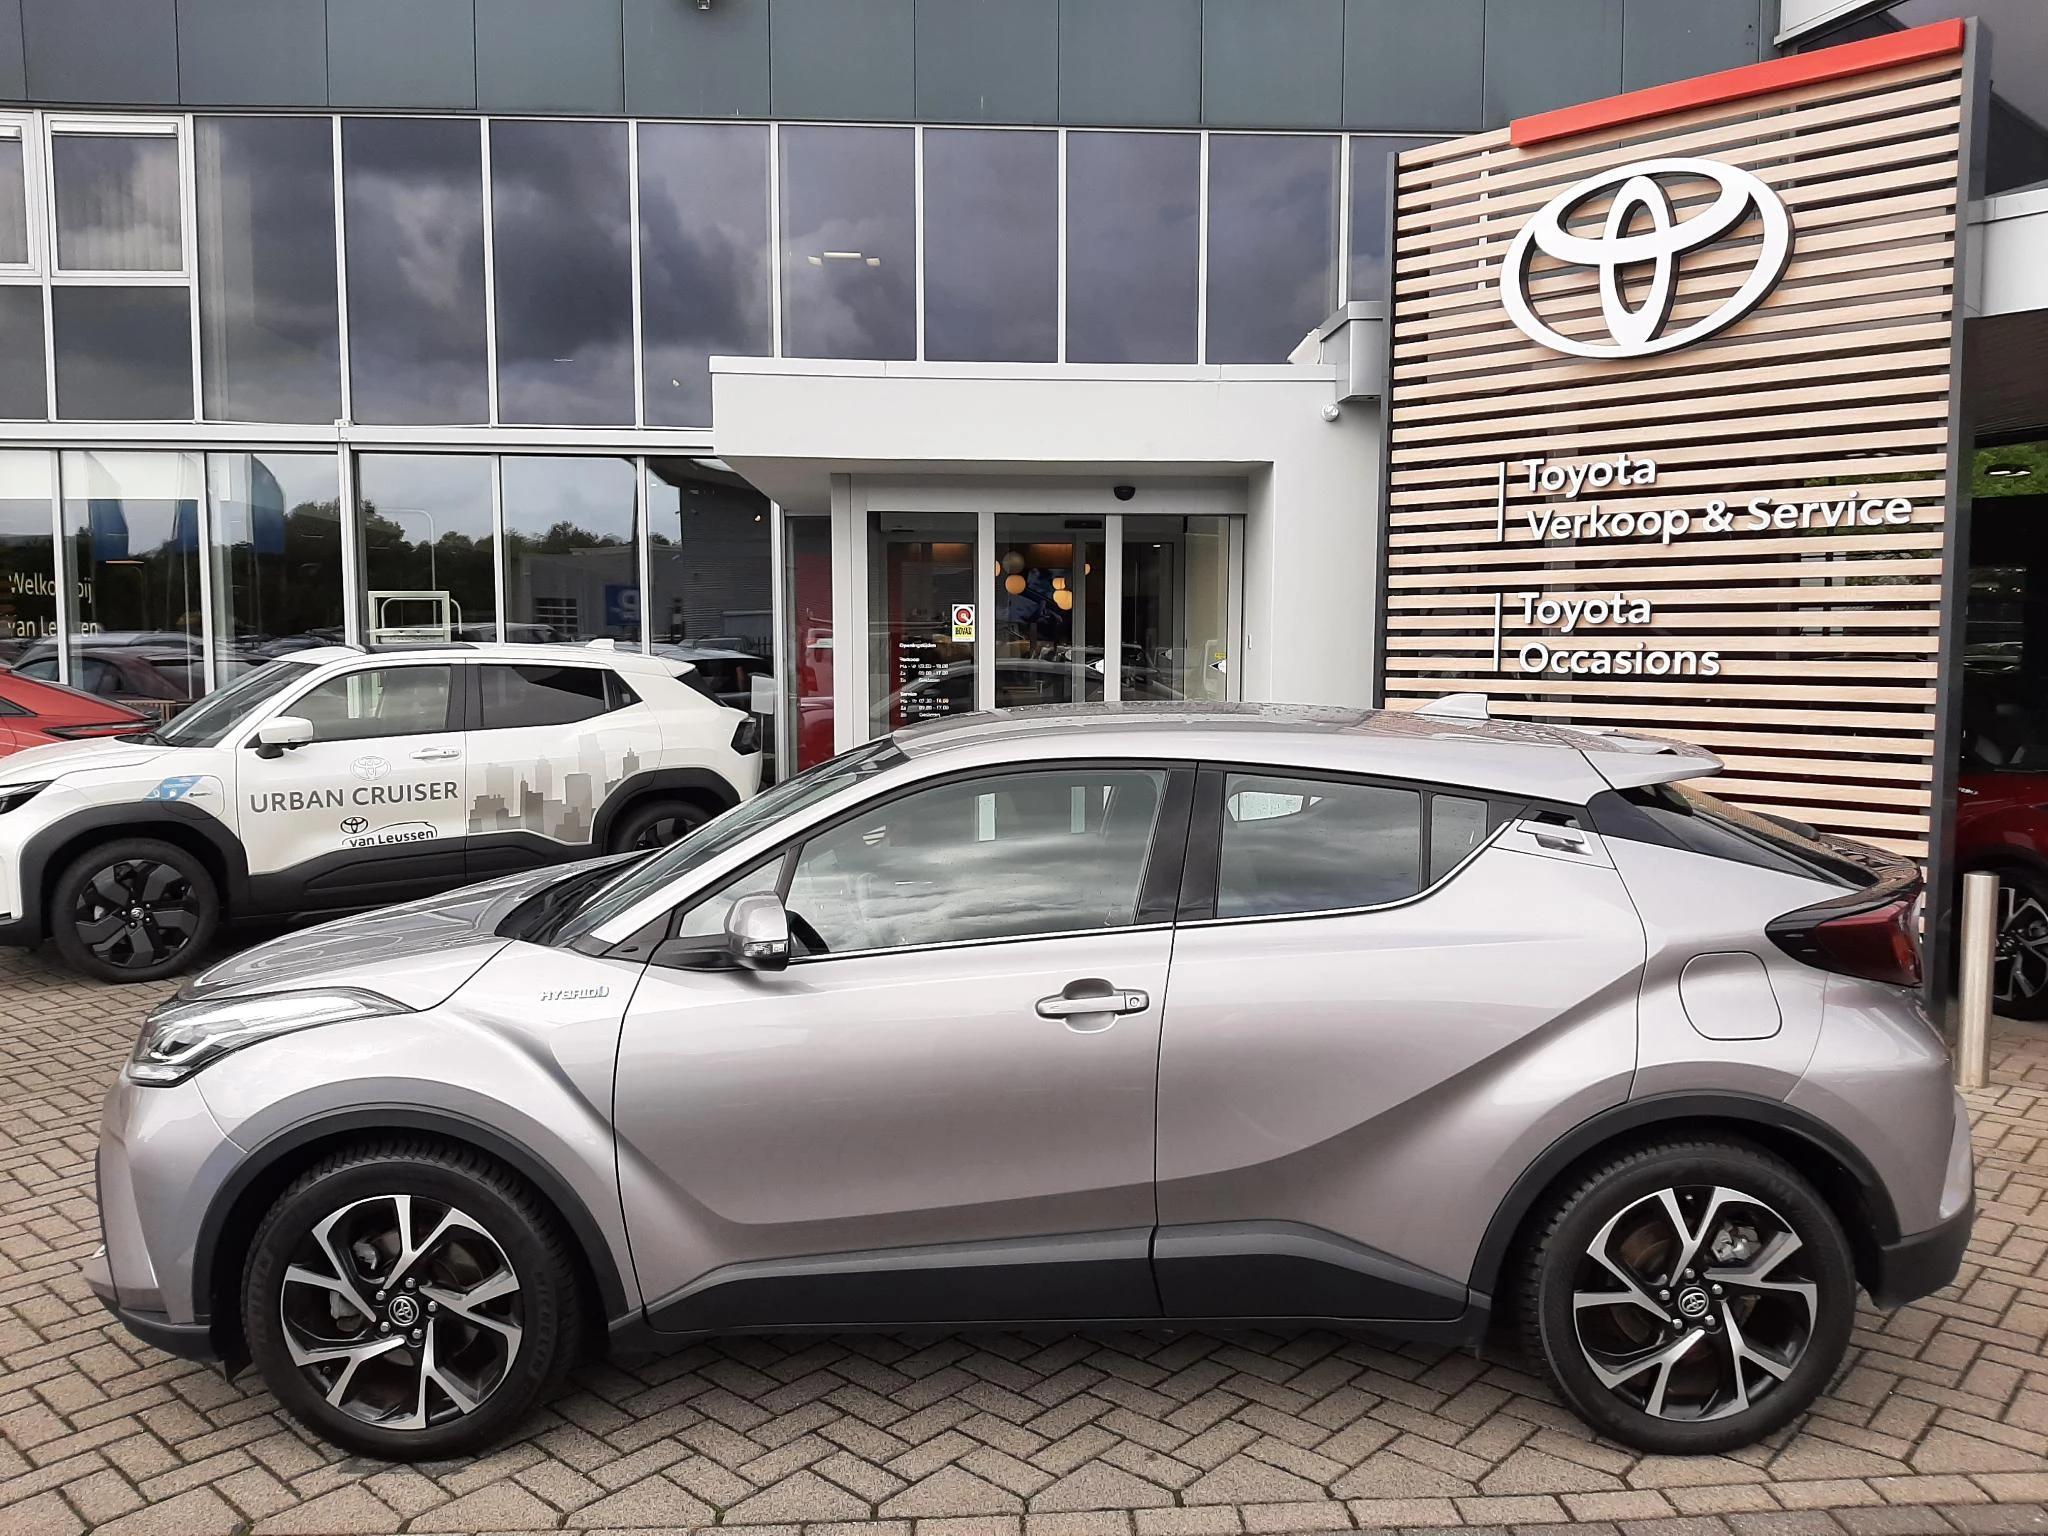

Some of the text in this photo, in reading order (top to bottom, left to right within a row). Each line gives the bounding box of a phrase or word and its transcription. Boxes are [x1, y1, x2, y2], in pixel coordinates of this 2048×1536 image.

[1522, 454, 1657, 498] Toyota
[1527, 491, 1913, 545] Verkoop & Service
[9, 572, 56, 596] Welko
[1518, 592, 1652, 633] Toyota
[1519, 642, 1721, 677] Occasions
[250, 781, 459, 813] URBAN CRUISER
[349, 829, 434, 848] van Leussen
[540, 985, 610, 1002] HYBRID
